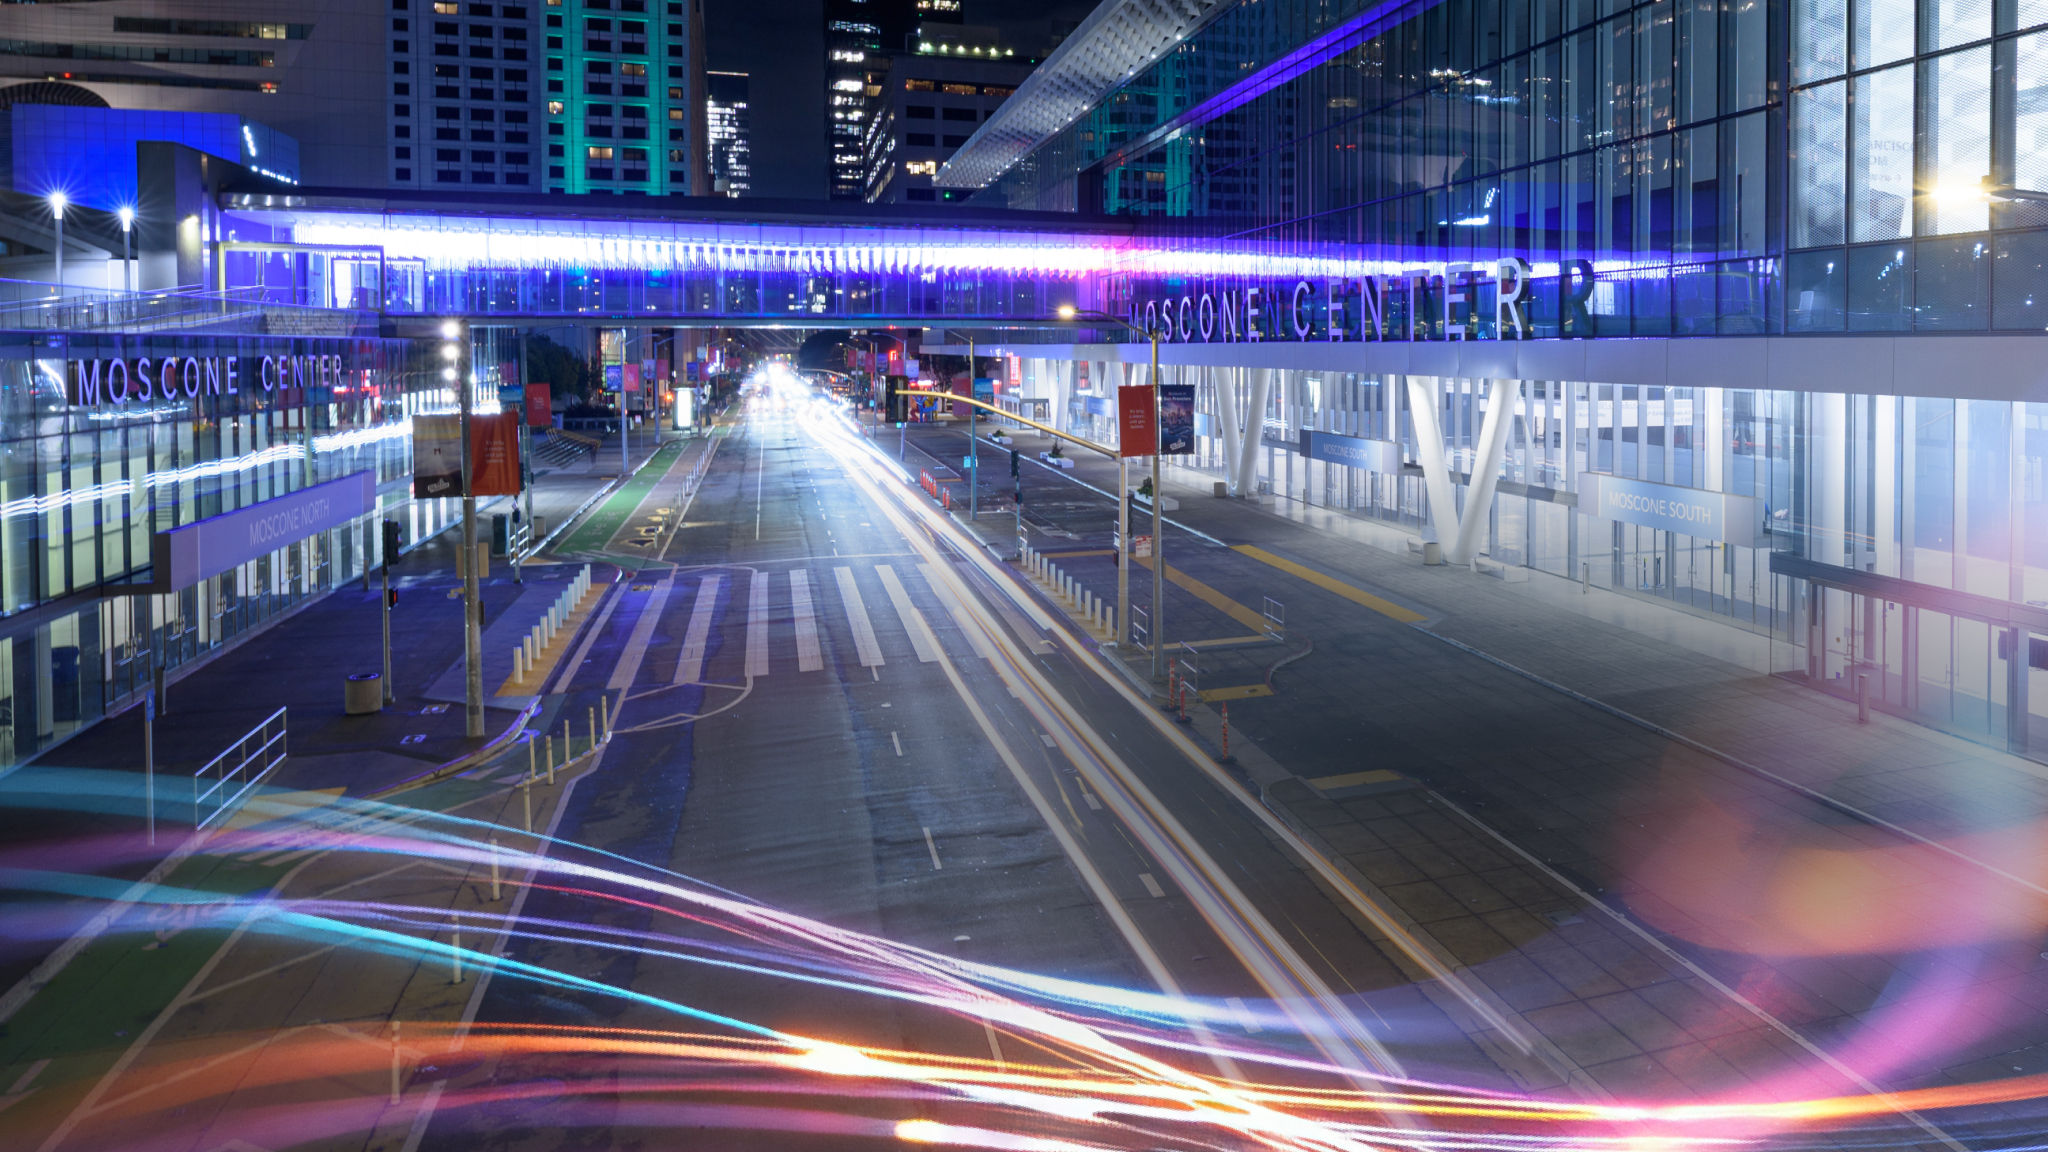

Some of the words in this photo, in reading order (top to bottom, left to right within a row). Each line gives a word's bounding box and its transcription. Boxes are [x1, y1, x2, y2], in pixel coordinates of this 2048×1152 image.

[1128, 287, 1260, 344] MOSCONE
[1293, 257, 1530, 342] CENTER
[78, 356, 238, 407] MOSCONE
[261, 354, 342, 392] CENTER
[1323, 443, 1349, 458] MOSCONE
[1349, 447, 1368, 461] SOUTH
[249, 507, 299, 547] MOSCONE
[301, 497, 330, 527] NORTH
[1609, 491, 1666, 516] MOSCONE
[1669, 501, 1711, 525] SOUTH
